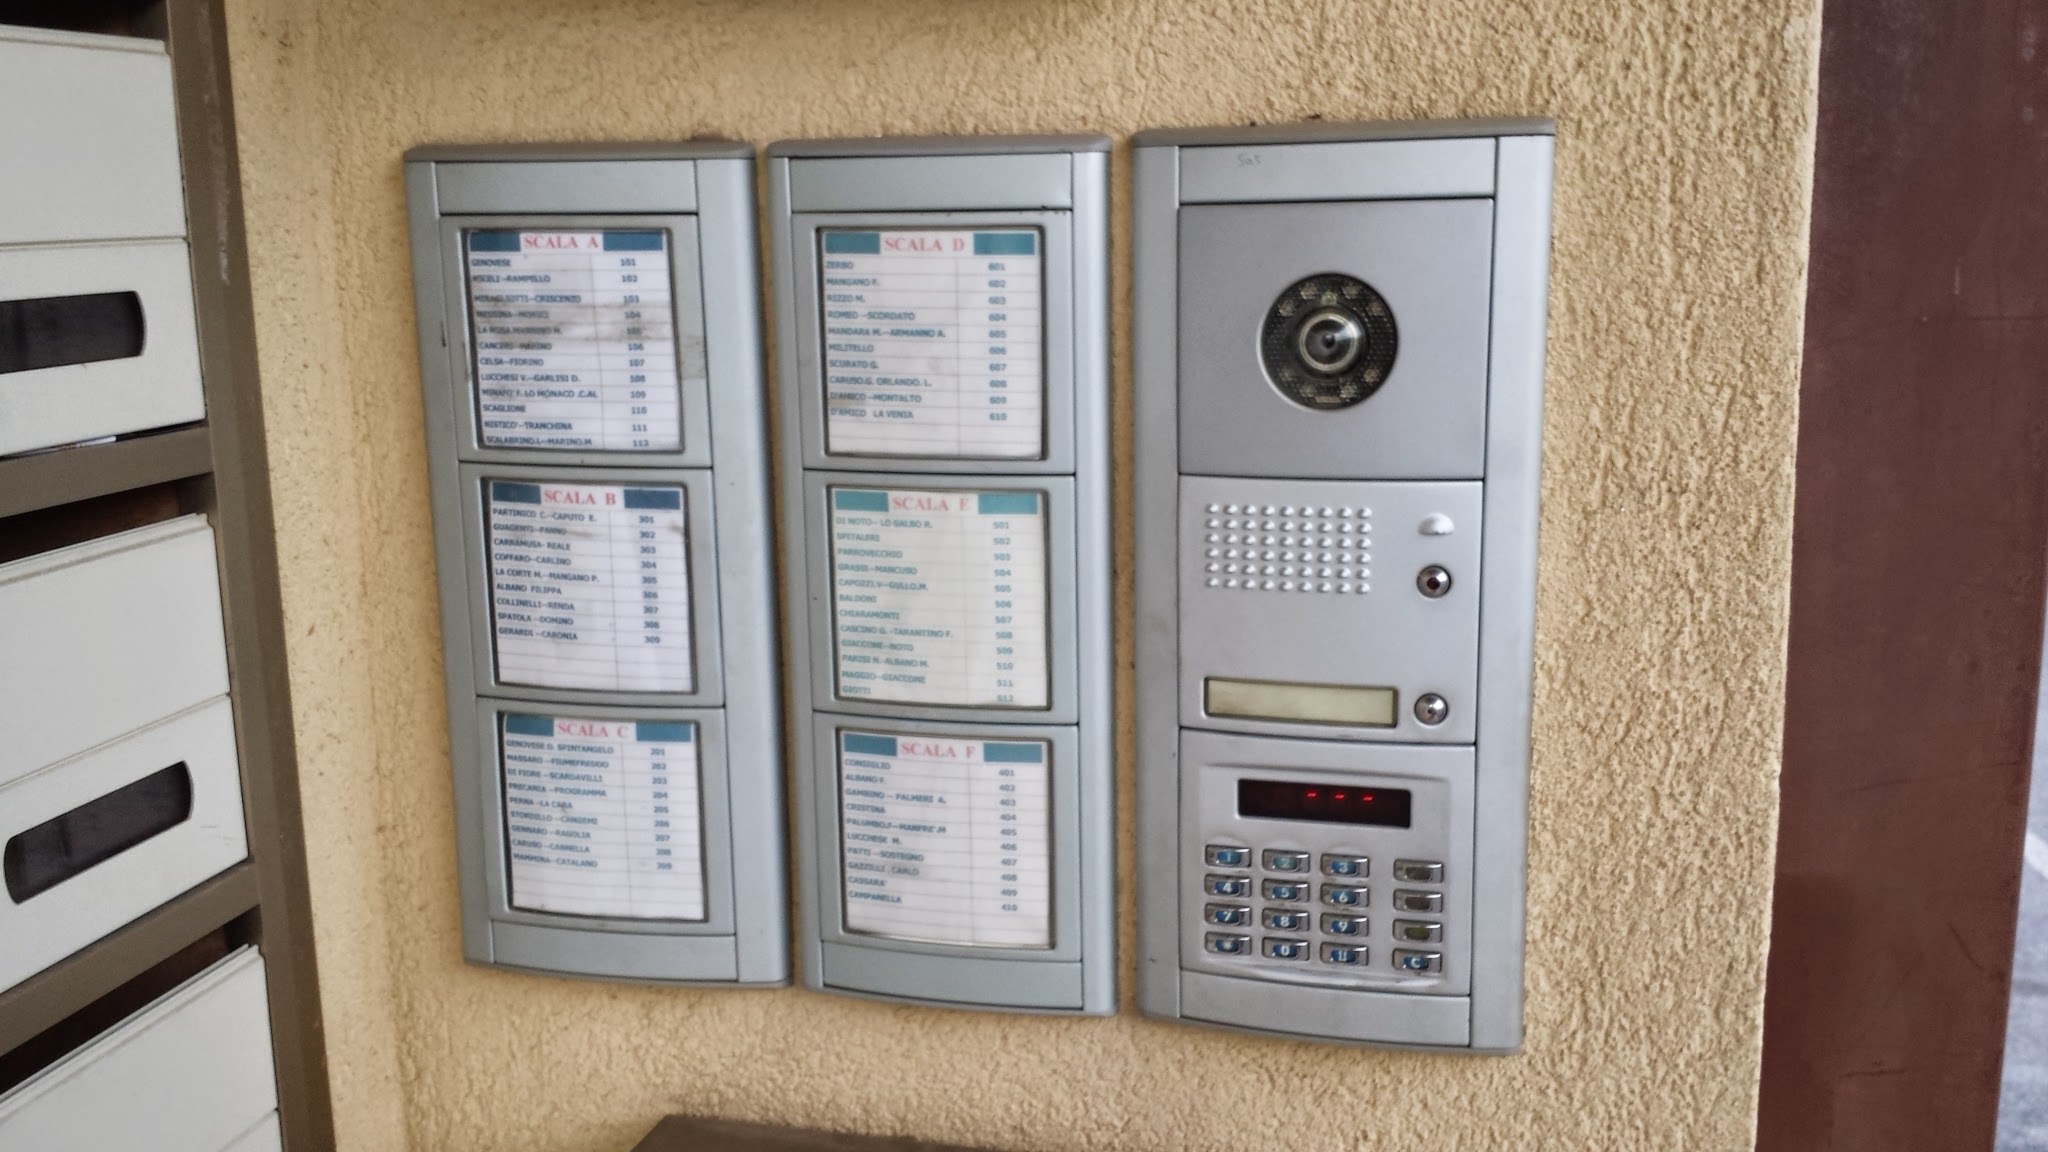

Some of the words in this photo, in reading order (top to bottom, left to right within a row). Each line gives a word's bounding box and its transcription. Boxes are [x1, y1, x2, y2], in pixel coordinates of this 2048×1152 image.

[524, 236, 578, 249] SCALA
[588, 236, 598, 248] A
[885, 238, 942, 251] SCALA
[953, 239, 965, 251] D
[632, 424, 647, 432] 111
[544, 490, 596, 505] SCALA
[605, 493, 616, 505] B
[893, 496, 948, 511] SCALA
[959, 499, 969, 510] E
[558, 723, 608, 737] SCALA
[617, 725, 628, 737] C
[901, 743, 955, 758] SCALA
[966, 746, 976, 758] F
[1226, 852, 1231, 861] 1
[1282, 858, 1288, 866] 2
[1339, 862, 1347, 872] 3
[1223, 882, 1231, 892] 4
[1281, 888, 1288, 897] 5
[1339, 892, 1347, 902] 6
[1224, 911, 1231, 922] 7
[1281, 917, 1289, 927] 8
[1339, 922, 1347, 932] 9
[1411, 957, 1420, 968] C
